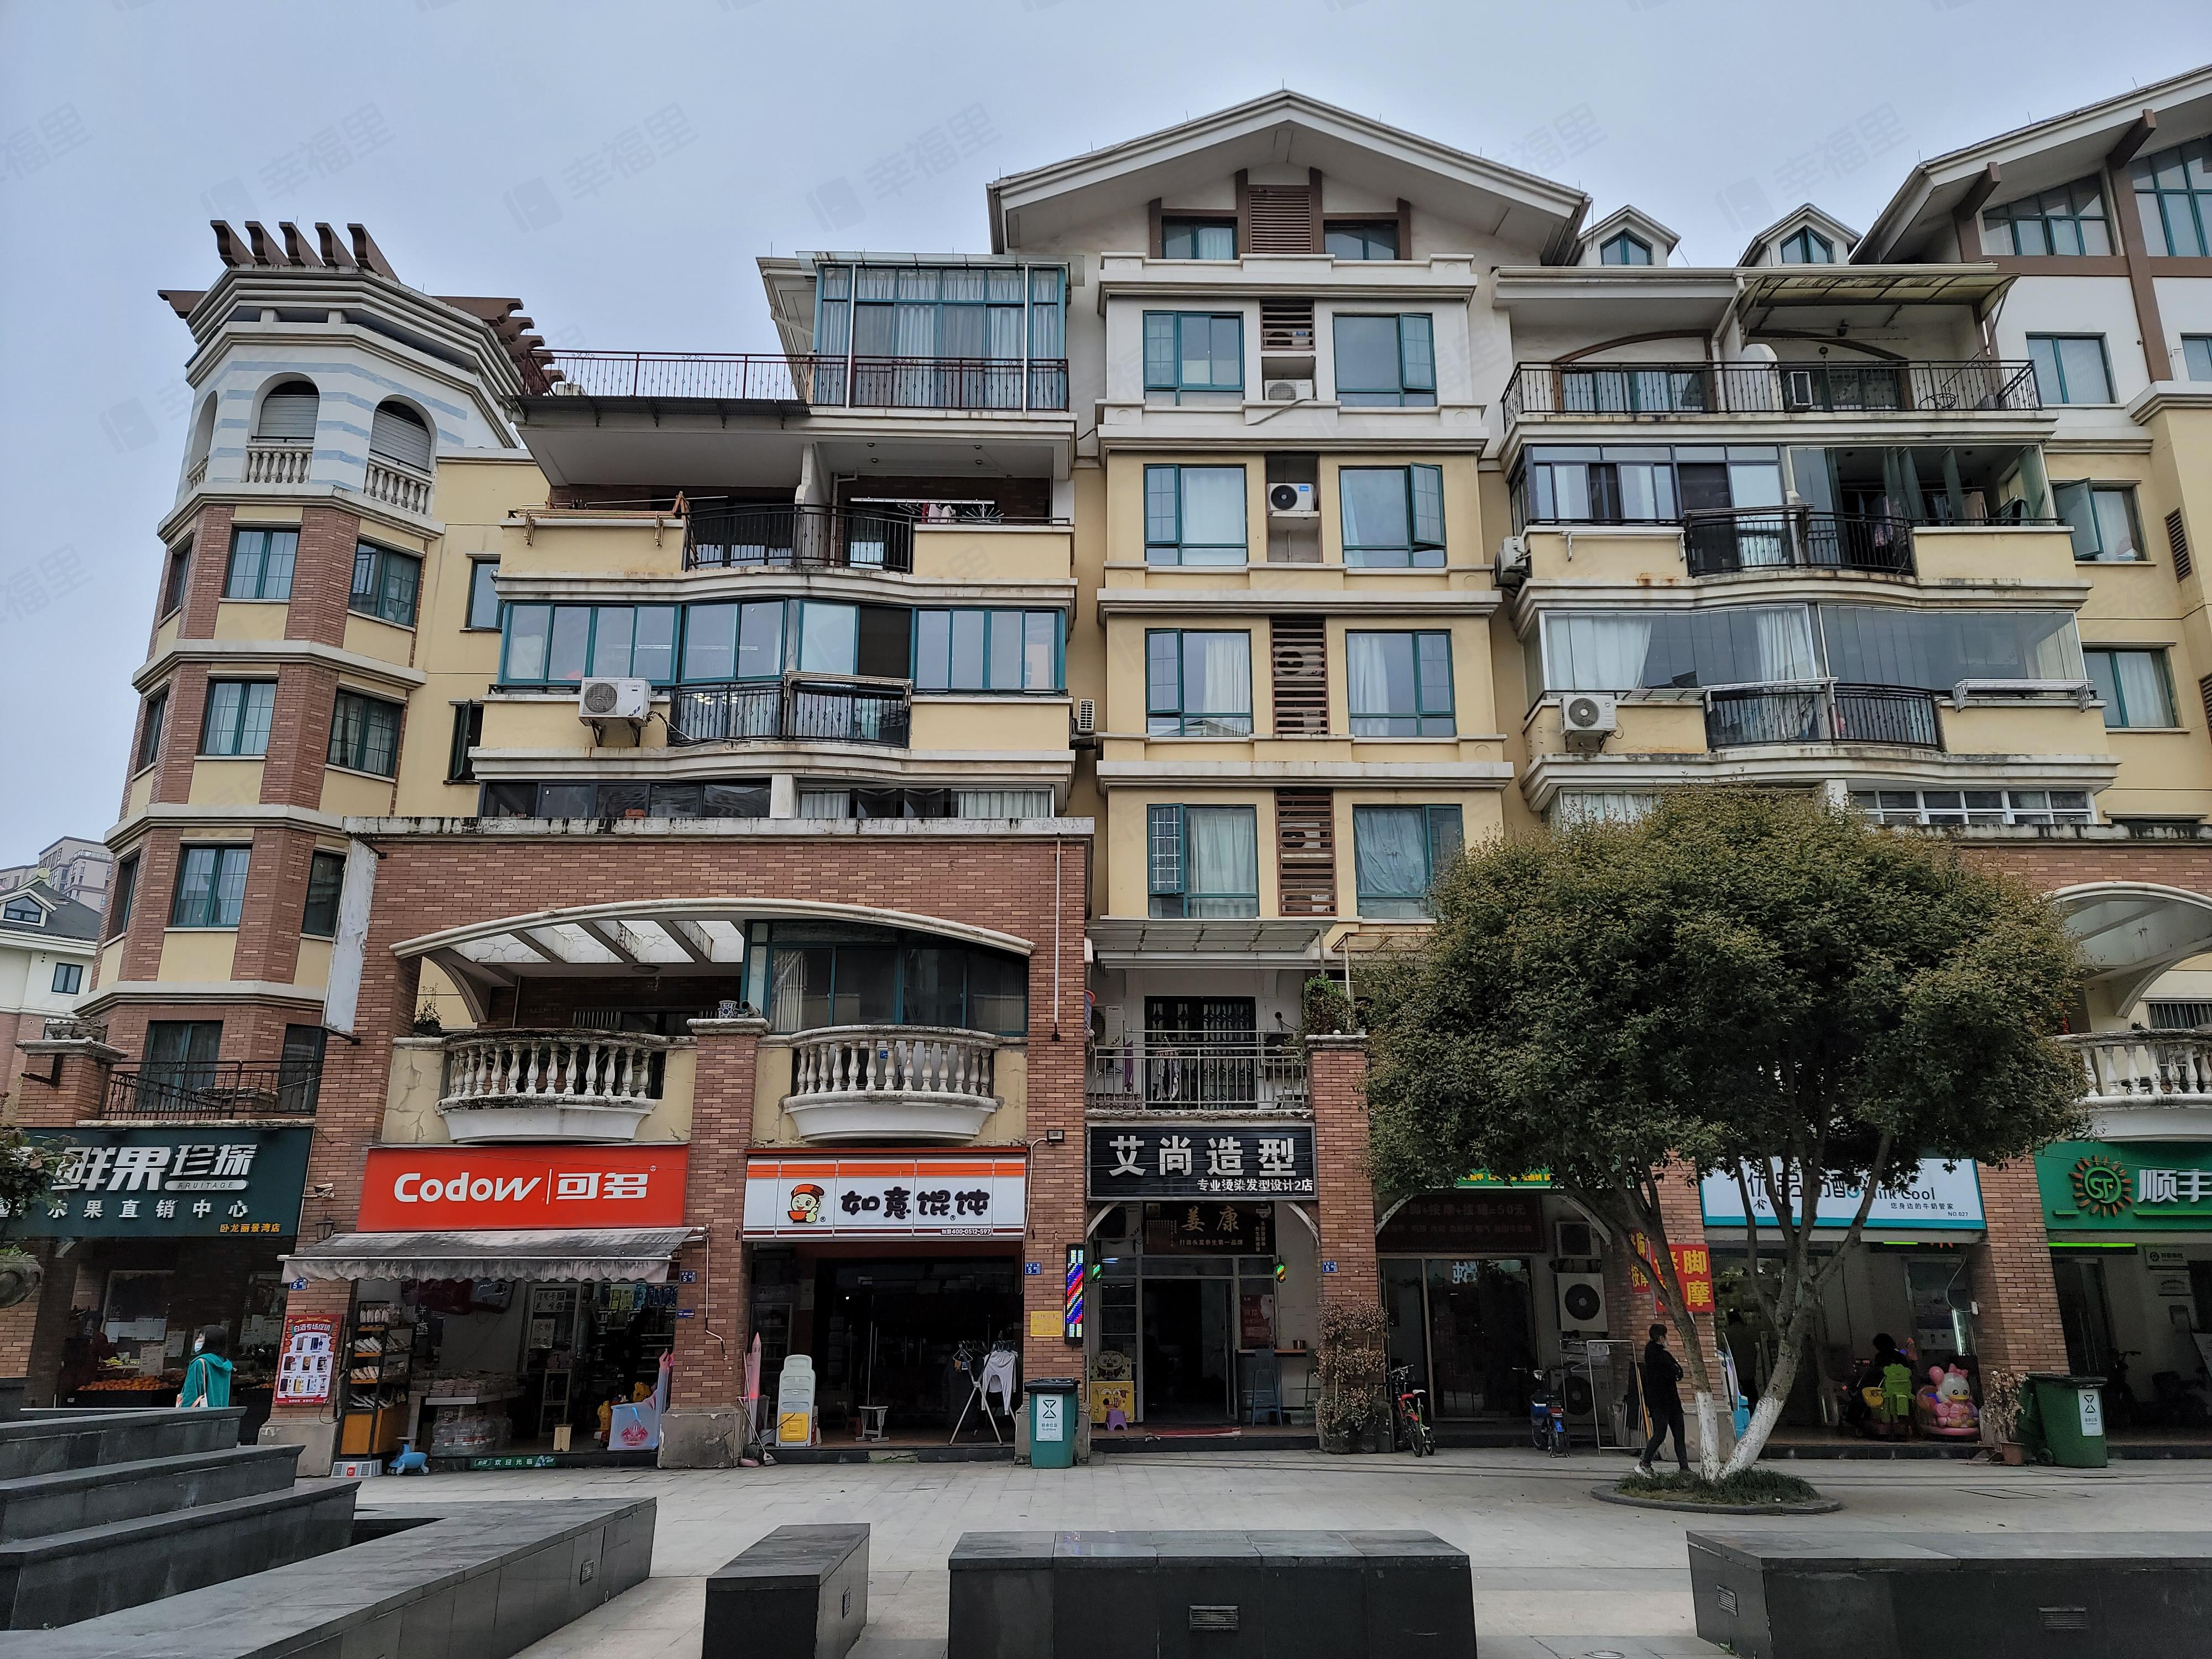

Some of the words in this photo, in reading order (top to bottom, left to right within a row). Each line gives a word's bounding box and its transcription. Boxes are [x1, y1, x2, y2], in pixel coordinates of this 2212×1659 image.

[1109, 1135, 1297, 1177] 艾尚造型
[394, 1172, 542, 1202] Codow
[556, 1172, 649, 1199] 可多
[1197, 1178, 1313, 1192] 专业烫染发型设计2店
[46, 1198, 249, 1219] 水果直销中心
[841, 1186, 990, 1219] 如意馄饨
[219, 1223, 281, 1233] 卧龙丽景湾店
